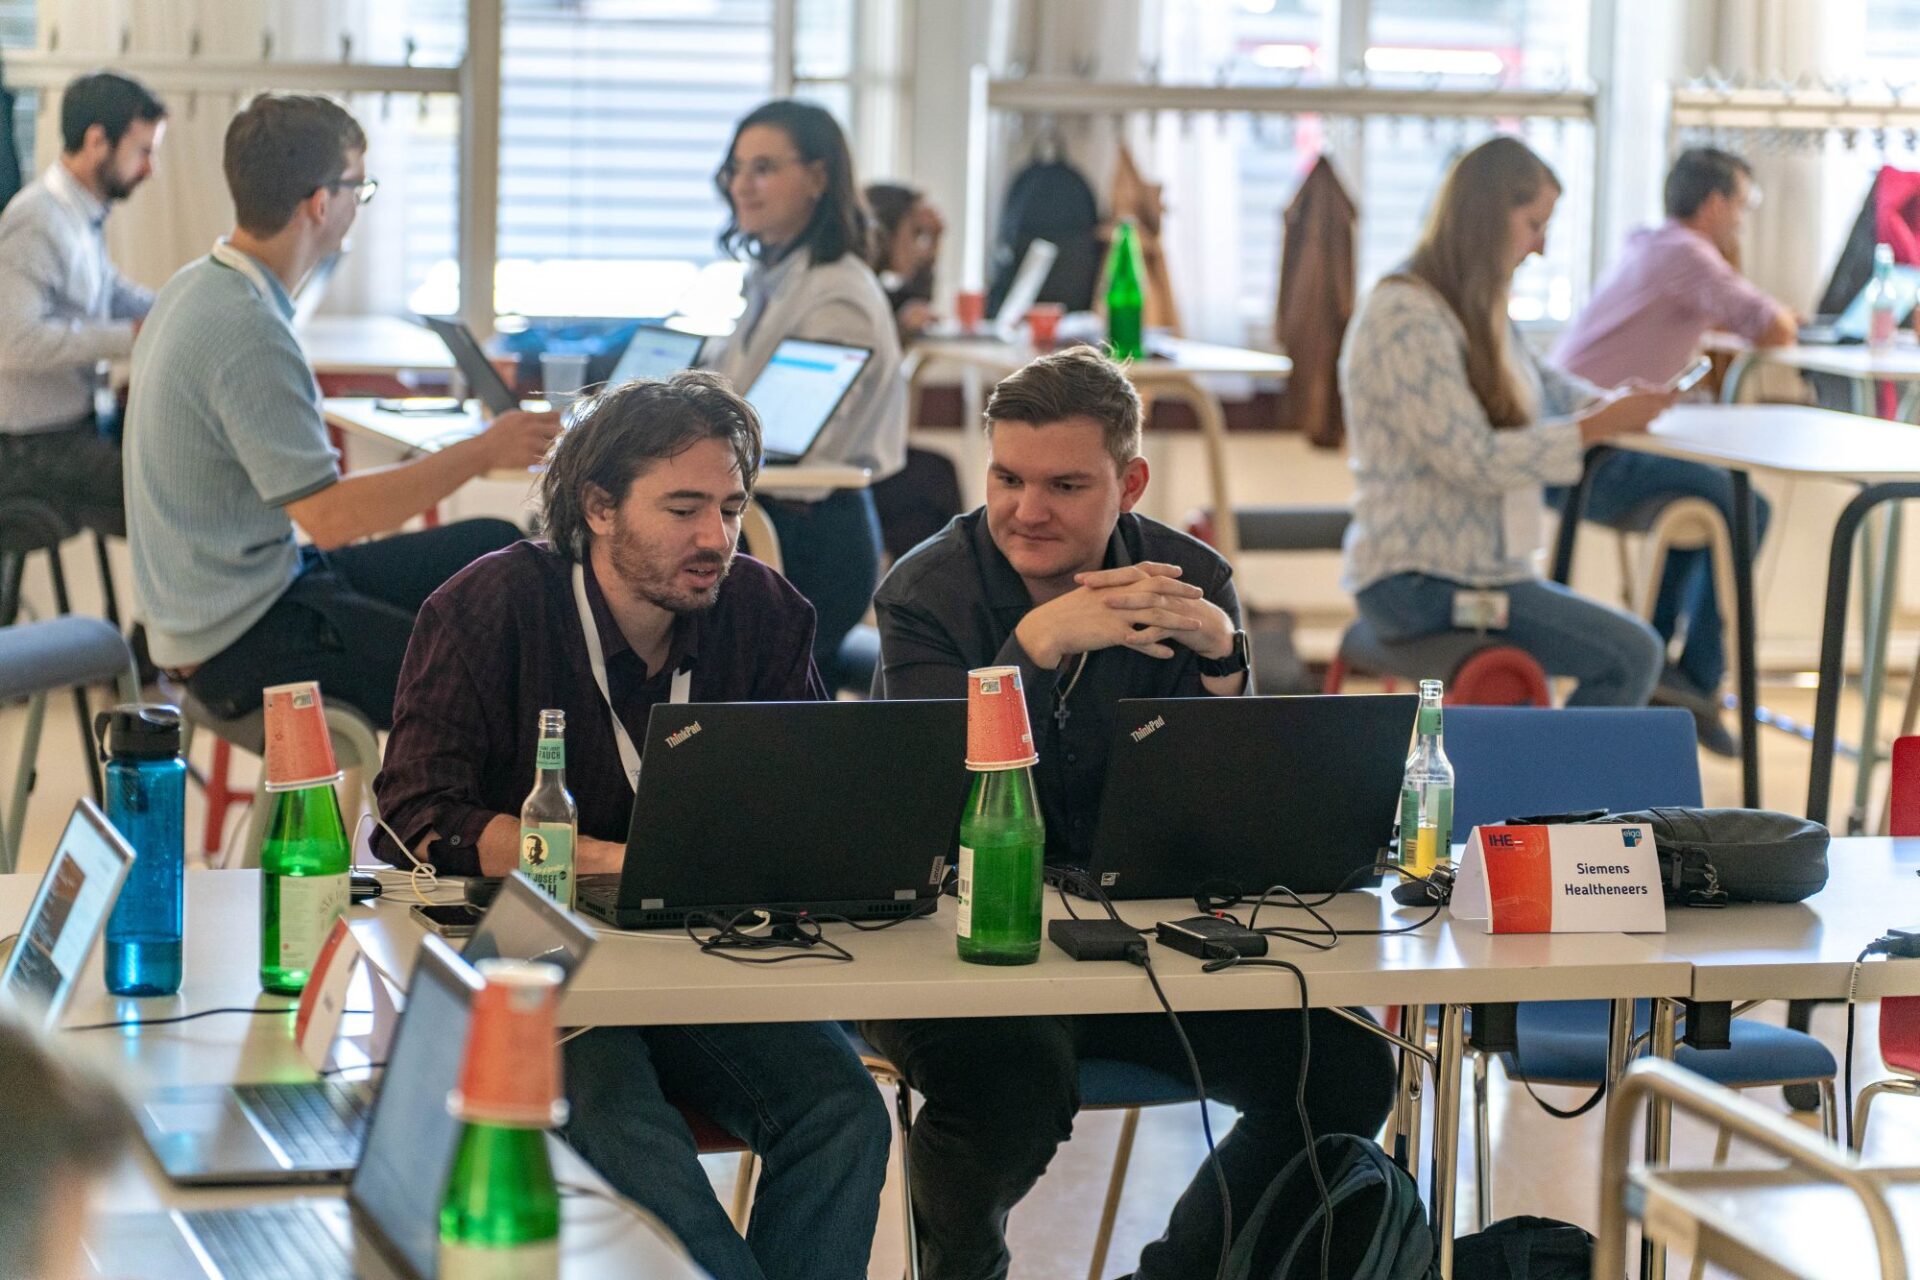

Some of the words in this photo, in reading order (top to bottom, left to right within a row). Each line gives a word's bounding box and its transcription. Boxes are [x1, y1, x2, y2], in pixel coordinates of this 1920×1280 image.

[665, 721, 702, 748] ThinkPad
[1131, 715, 1165, 742] ThinkPad
[1489, 834, 1513, 847] IHE
[1577, 863, 1630, 874] Siemens
[533, 873, 557, 884] JOSEF
[1565, 883, 1648, 895] Healtheneers
